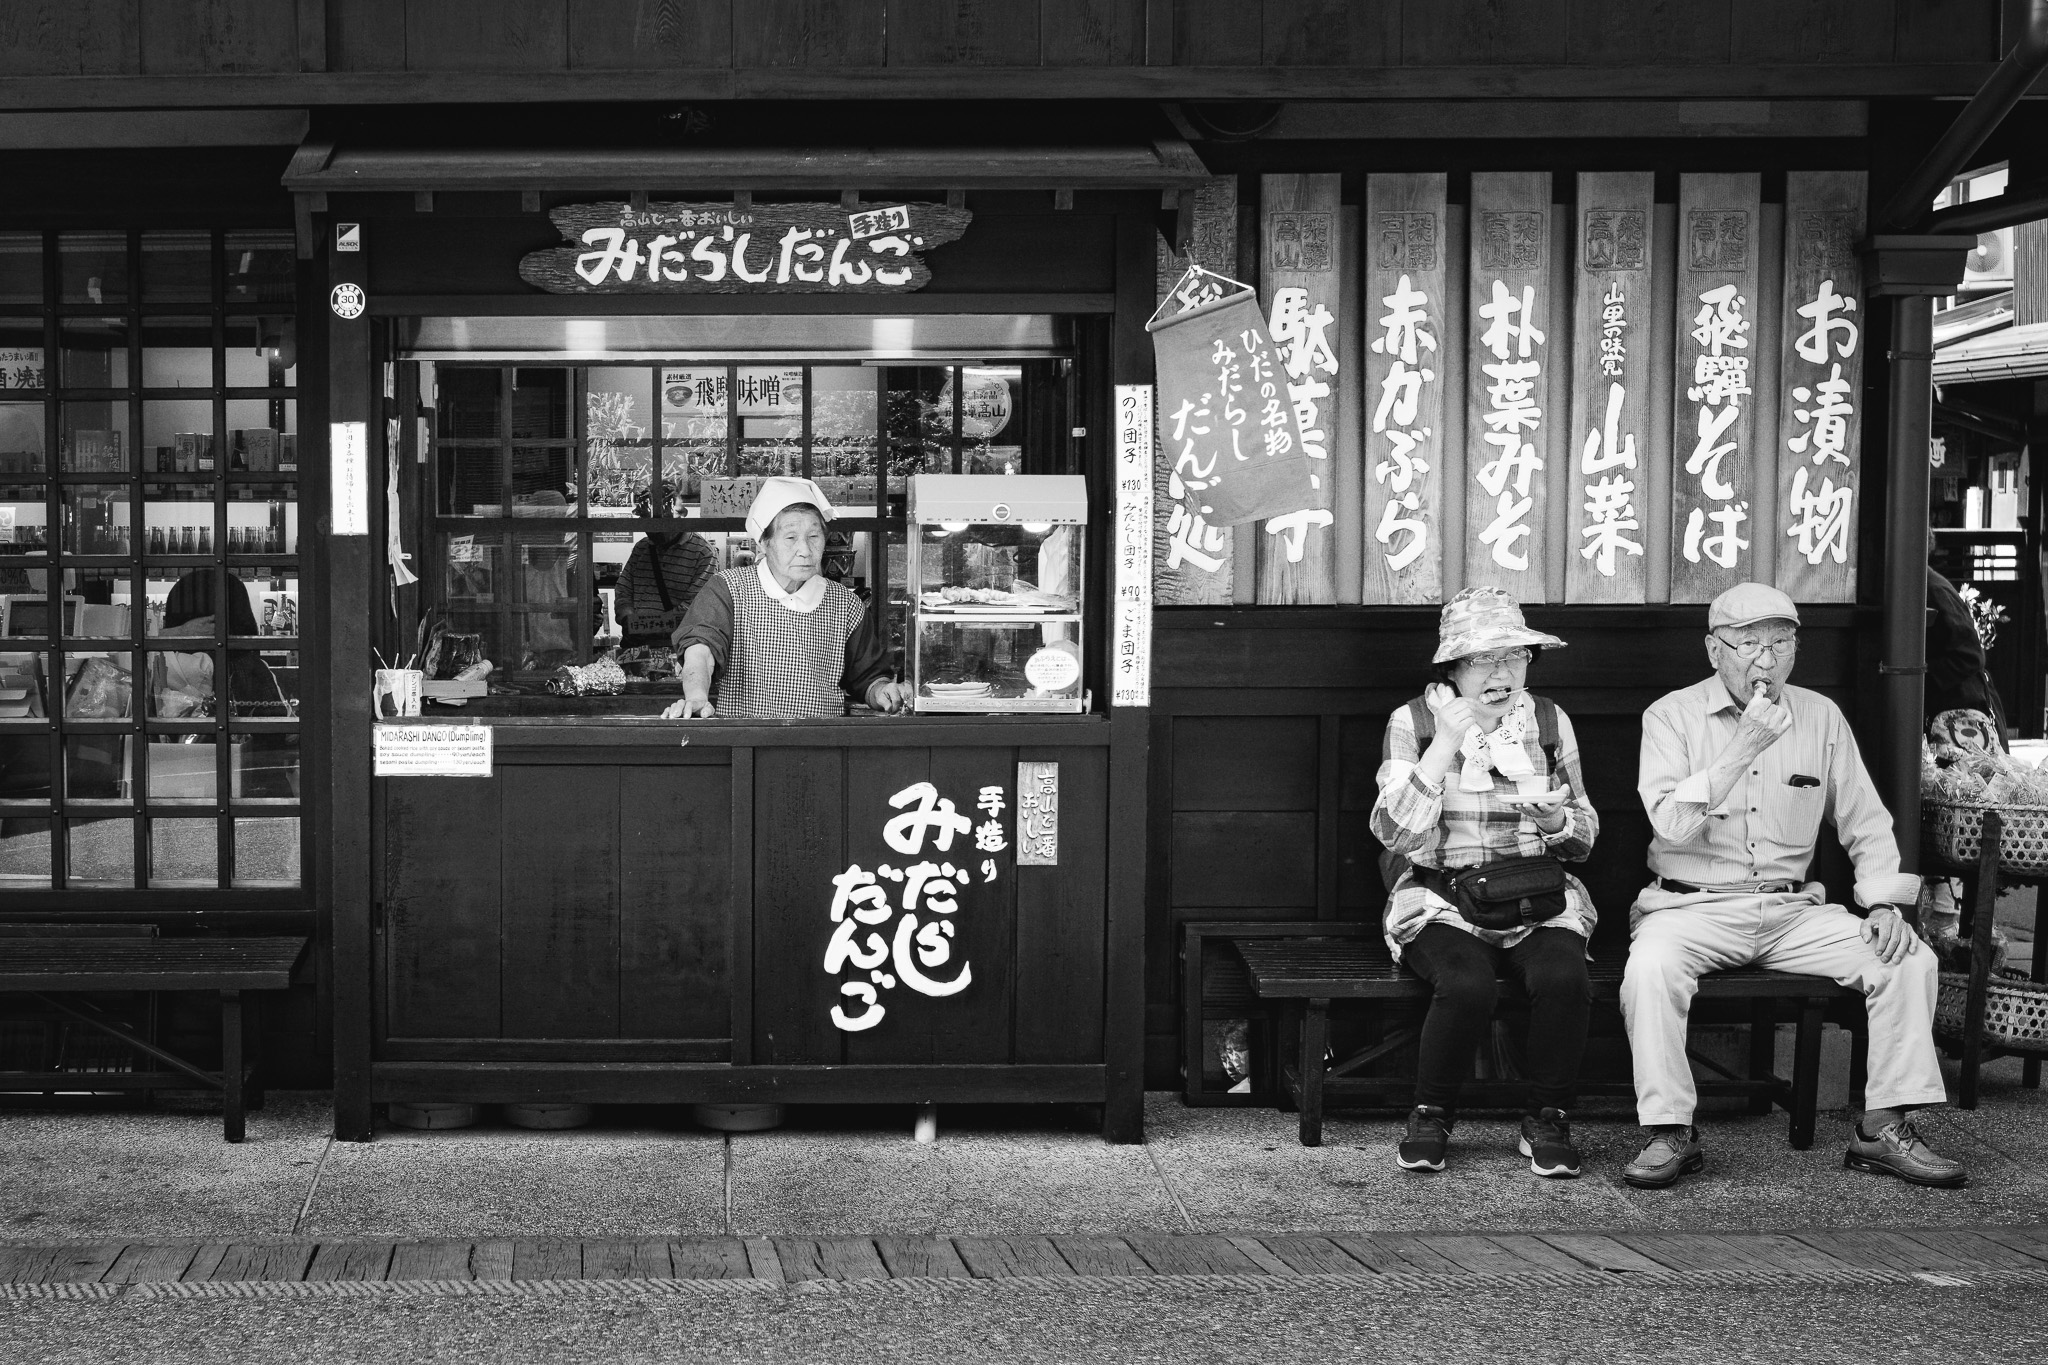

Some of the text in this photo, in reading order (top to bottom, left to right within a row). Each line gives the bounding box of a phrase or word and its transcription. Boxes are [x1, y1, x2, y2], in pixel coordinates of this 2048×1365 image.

[574, 224, 924, 287] みだらしだんご
[619, 205, 754, 228] 高山で一番おいしい
[341, 295, 355, 304] 30
[1122, 396, 1137, 464] のり団子
[1211, 339, 1250, 461] みだらし
[1239, 328, 1293, 457] ひだの名物
[1371, 273, 1437, 572] 赤かぶら
[1475, 279, 1546, 572] 朴葉みそ
[1580, 281, 1644, 577] 山里の味覚 山菜
[1787, 279, 1858, 565] お漬物
[1121, 480, 1141, 491] ¥130
[1121, 586, 1140, 597] ¥90
[1121, 608, 1135, 674] ごま団子
[380, 730, 420, 743] MIDARASHI
[422, 730, 447, 743] DANGO
[976, 786, 1008, 883] 手造り
[1037, 768, 1057, 858] 高山で一番
[882, 781, 972, 997] みだらし
[824, 863, 904, 1032] だんご
